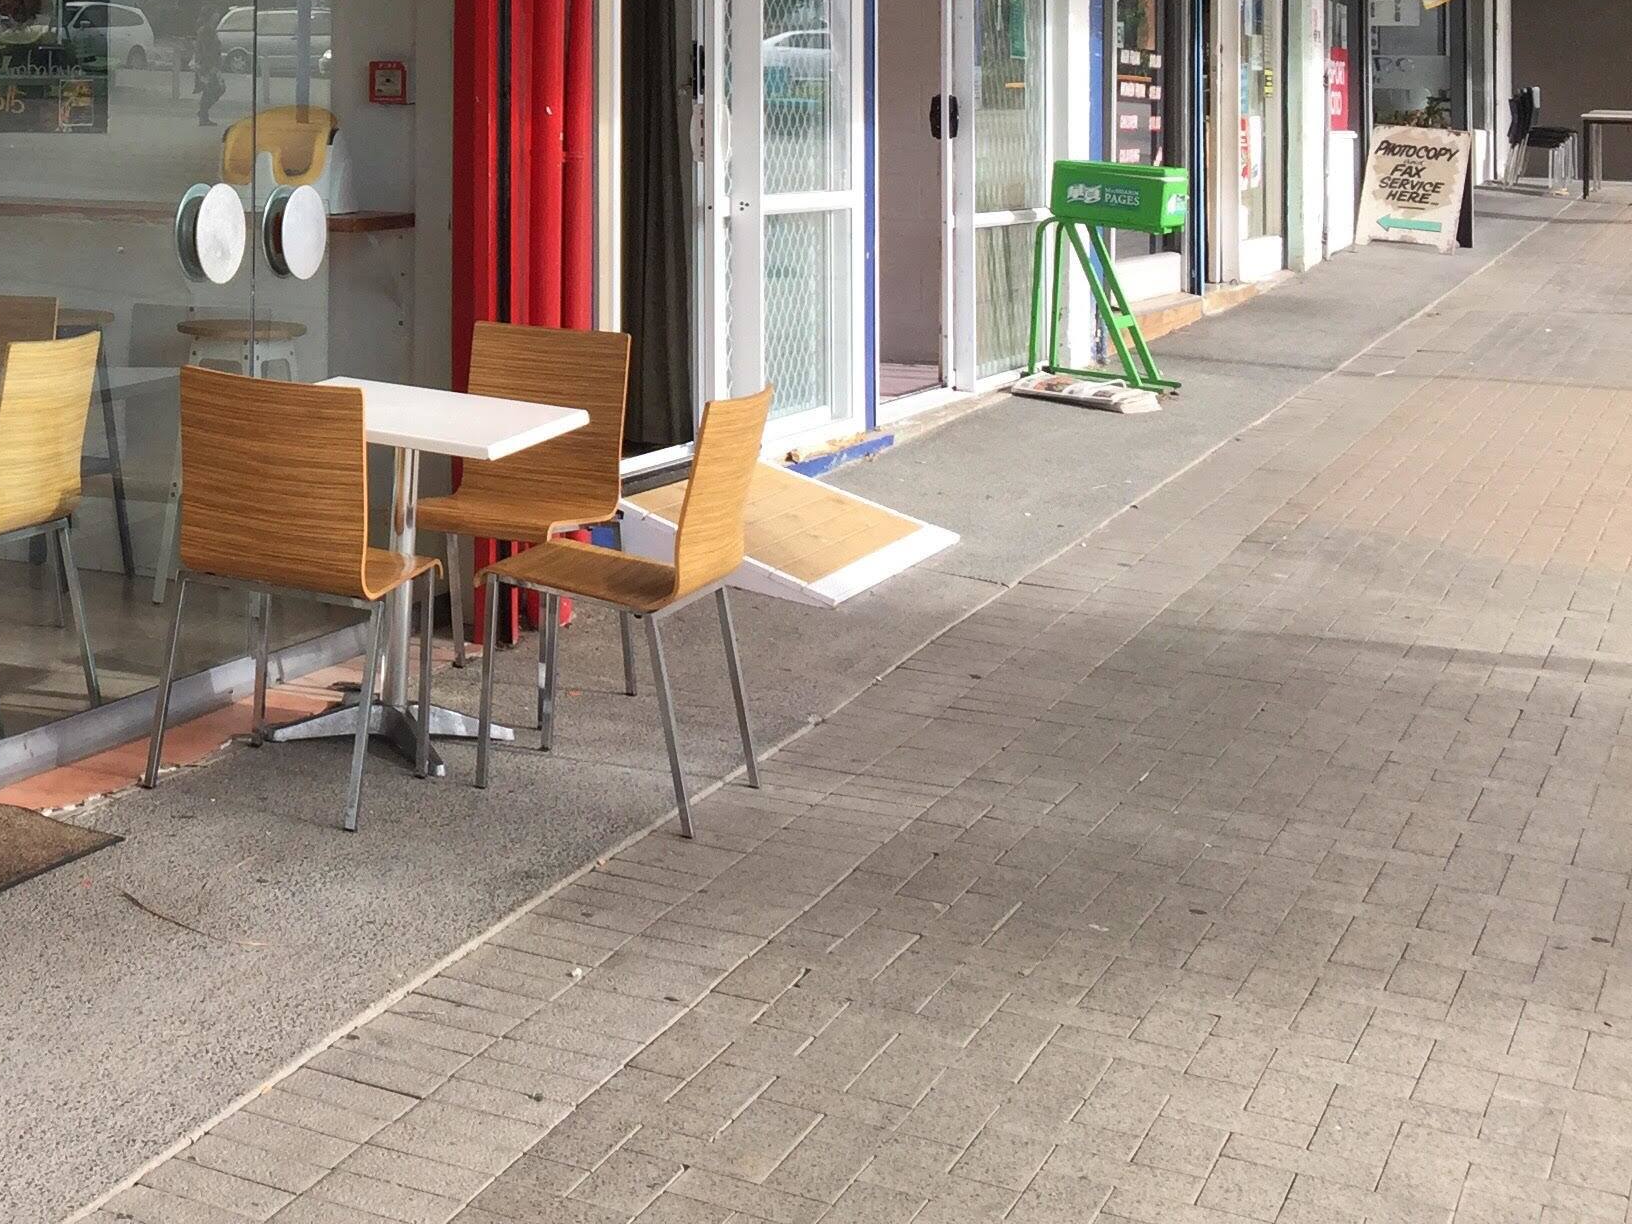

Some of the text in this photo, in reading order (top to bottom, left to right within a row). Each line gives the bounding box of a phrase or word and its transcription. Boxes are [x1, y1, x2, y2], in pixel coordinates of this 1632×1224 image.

[1374, 139, 1459, 162] PHOTOCOPY
[1390, 163, 1426, 179] FAX
[1378, 176, 1445, 194] SERVICE
[1105, 193, 1140, 206] PAGES
